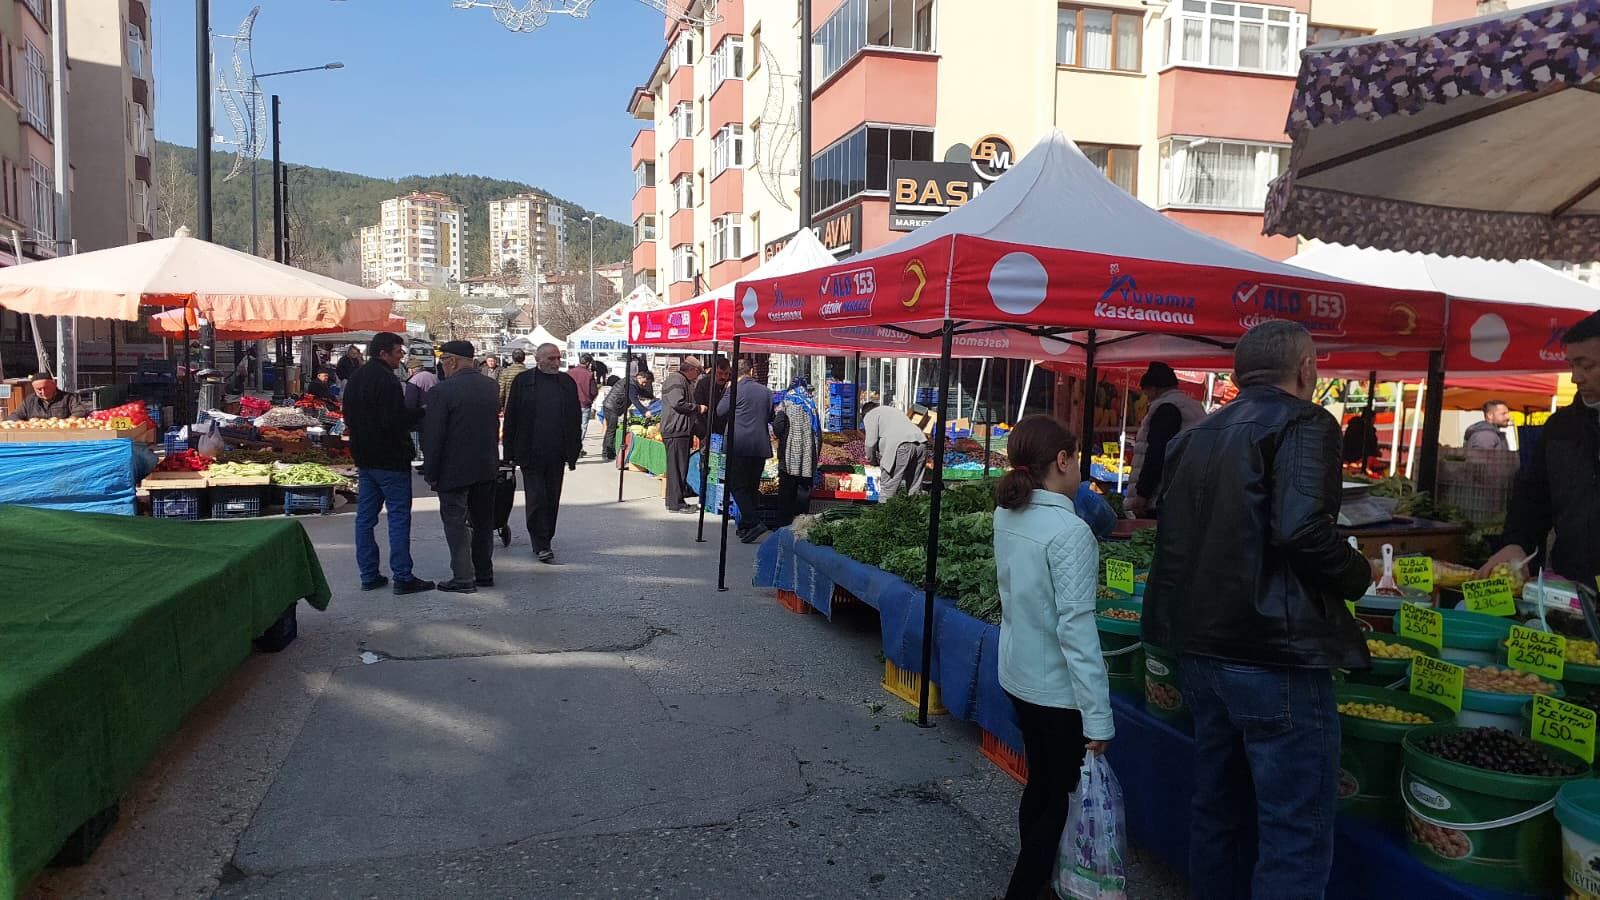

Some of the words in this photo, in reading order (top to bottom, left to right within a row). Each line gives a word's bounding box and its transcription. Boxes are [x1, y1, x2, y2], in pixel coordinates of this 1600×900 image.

[824, 213, 852, 248] AVM
[853, 271, 874, 295] 153
[1094, 302, 1195, 325] Kastamonu
[1308, 293, 1341, 318] 153
[580, 339, 615, 350] Manav
[1537, 696, 1552, 708] AZ
